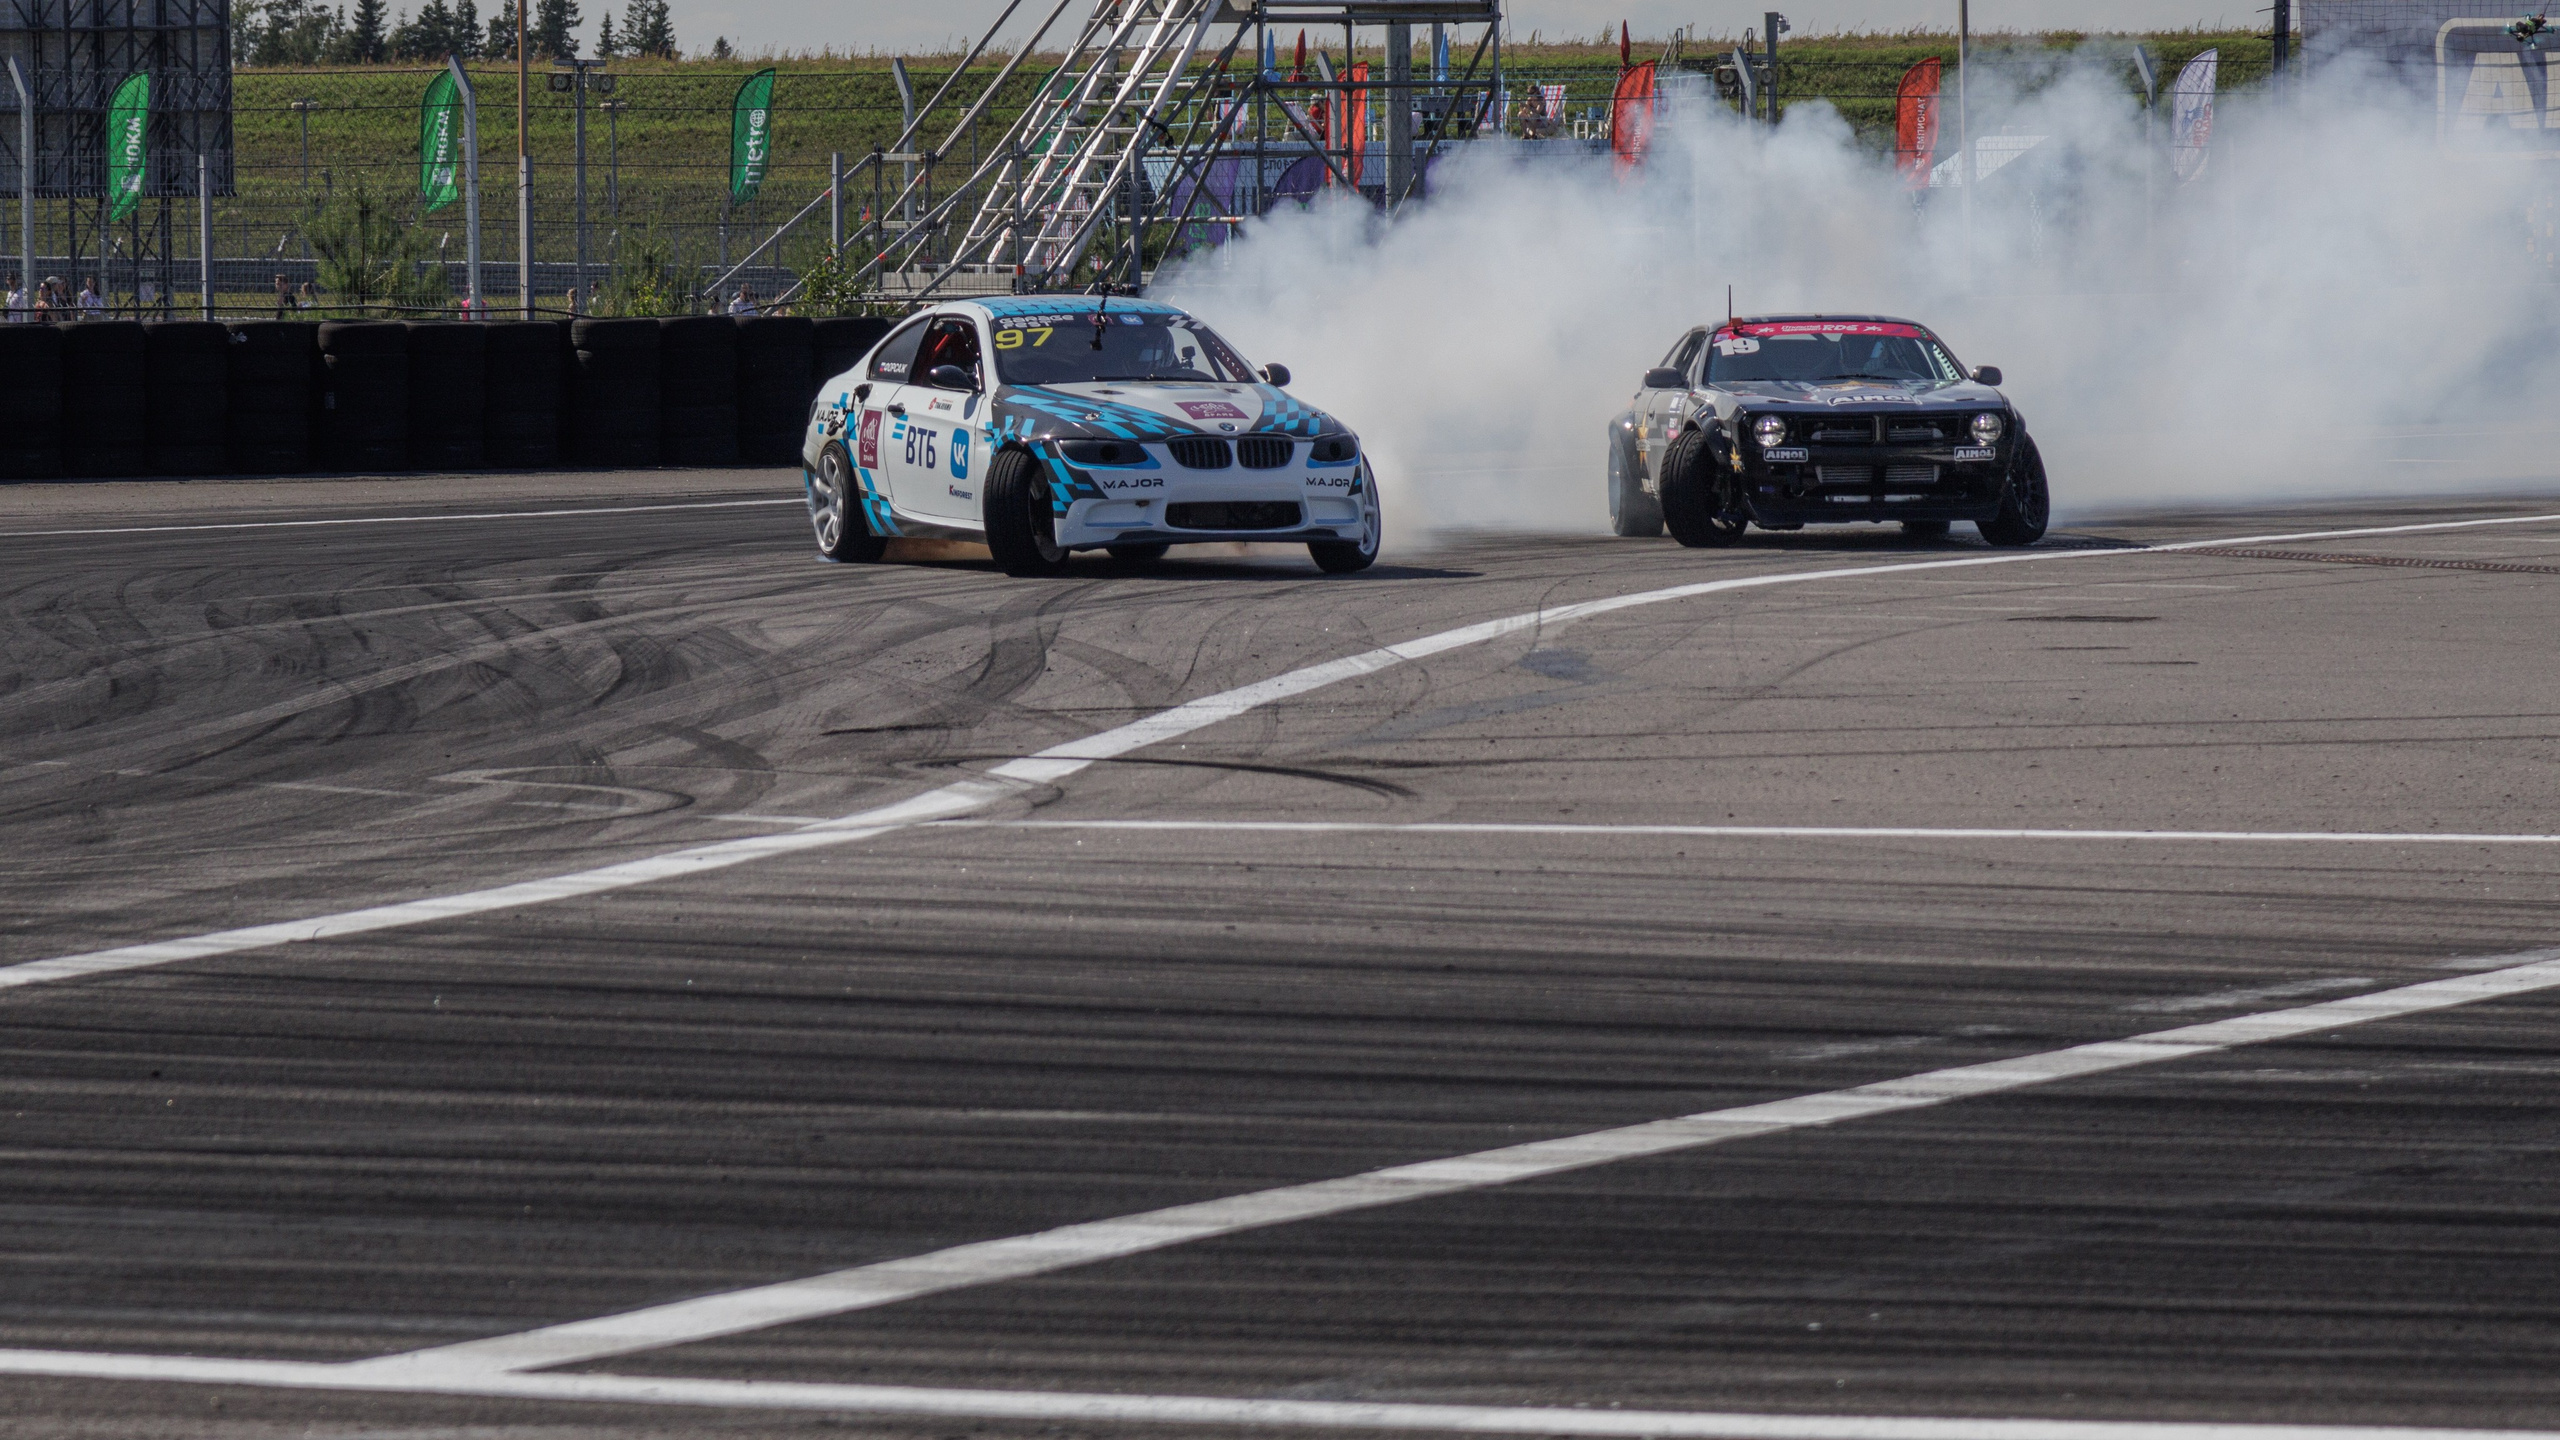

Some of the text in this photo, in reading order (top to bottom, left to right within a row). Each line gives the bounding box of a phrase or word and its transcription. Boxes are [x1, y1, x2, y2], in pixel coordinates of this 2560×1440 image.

[1916, 97, 1926, 156] ЧЕМПИОНАТ
[743, 109, 767, 184] metro
[998, 314, 1075, 324] GARAGE
[1002, 320, 1052, 329] FEST
[995, 326, 1054, 350] 97
[1712, 337, 1761, 356] 19
[906, 426, 938, 470] ВТБ
[953, 442, 967, 468] VK
[1766, 450, 1806, 460] AIMOL
[1956, 449, 1993, 459] AIMOL
[1102, 478, 1165, 490] MAJOR
[1305, 477, 1351, 488] MAJOR
